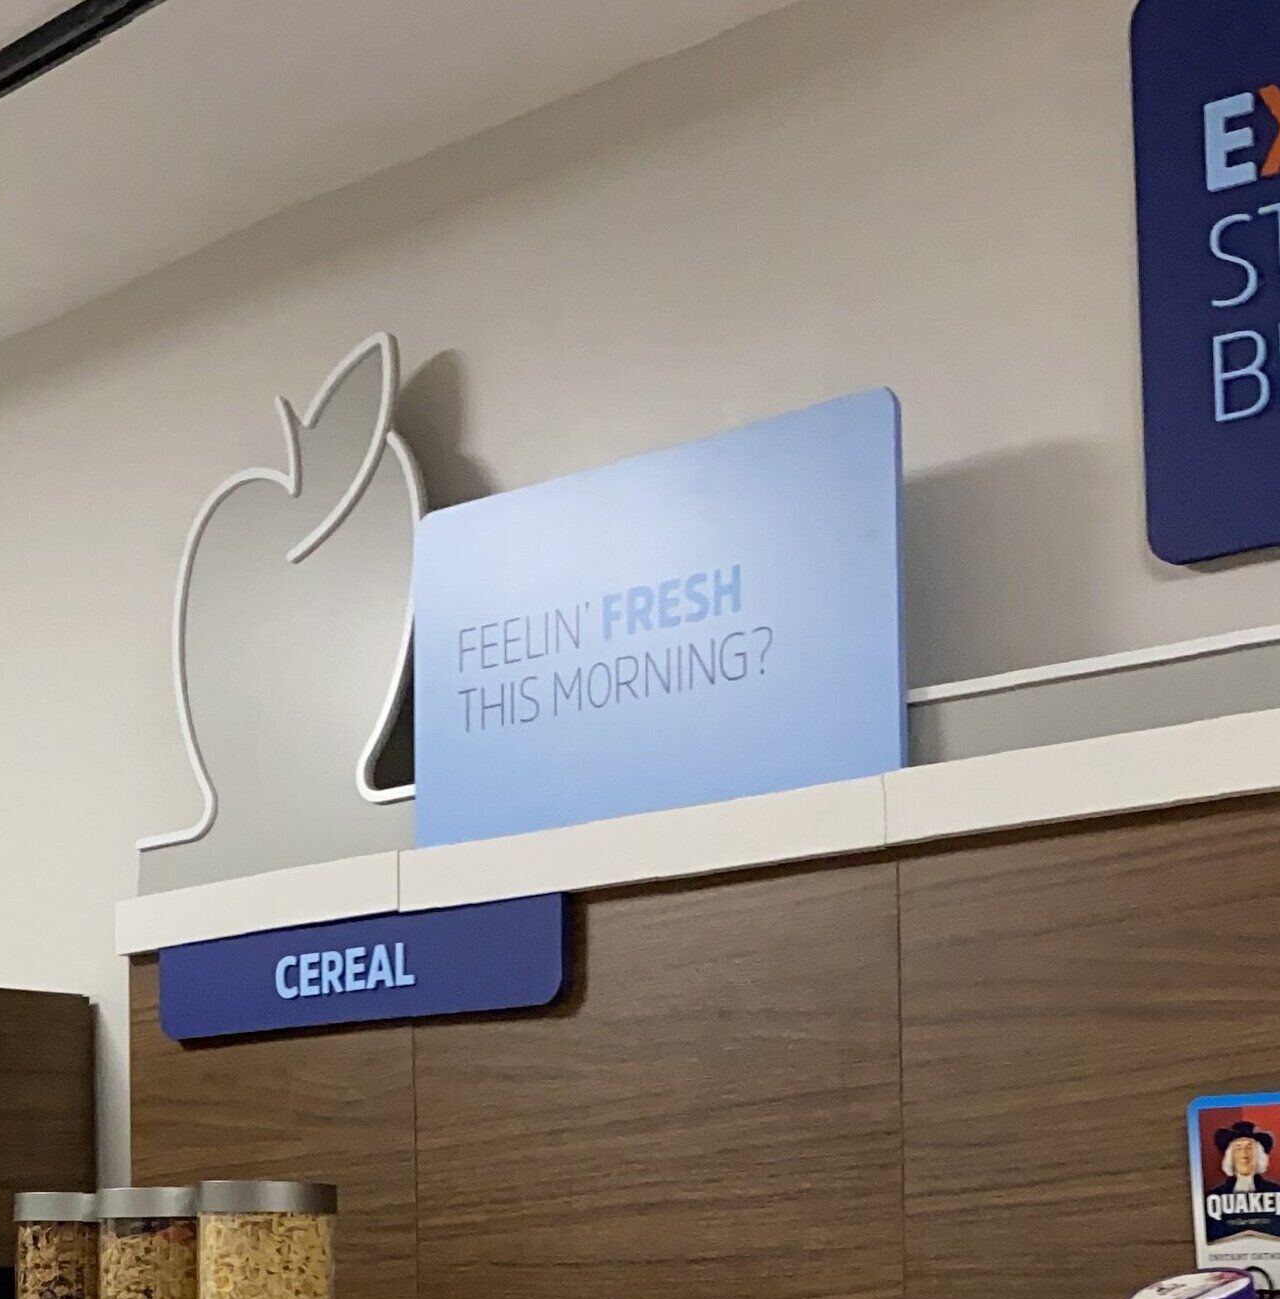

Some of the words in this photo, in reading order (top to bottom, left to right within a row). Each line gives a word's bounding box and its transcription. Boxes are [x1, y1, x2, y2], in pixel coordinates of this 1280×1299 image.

[601, 564, 742, 643] FRESH
[458, 680, 541, 734] THIS
[551, 626, 775, 719] MORNING?
[275, 942, 416, 1000] CEREAL
